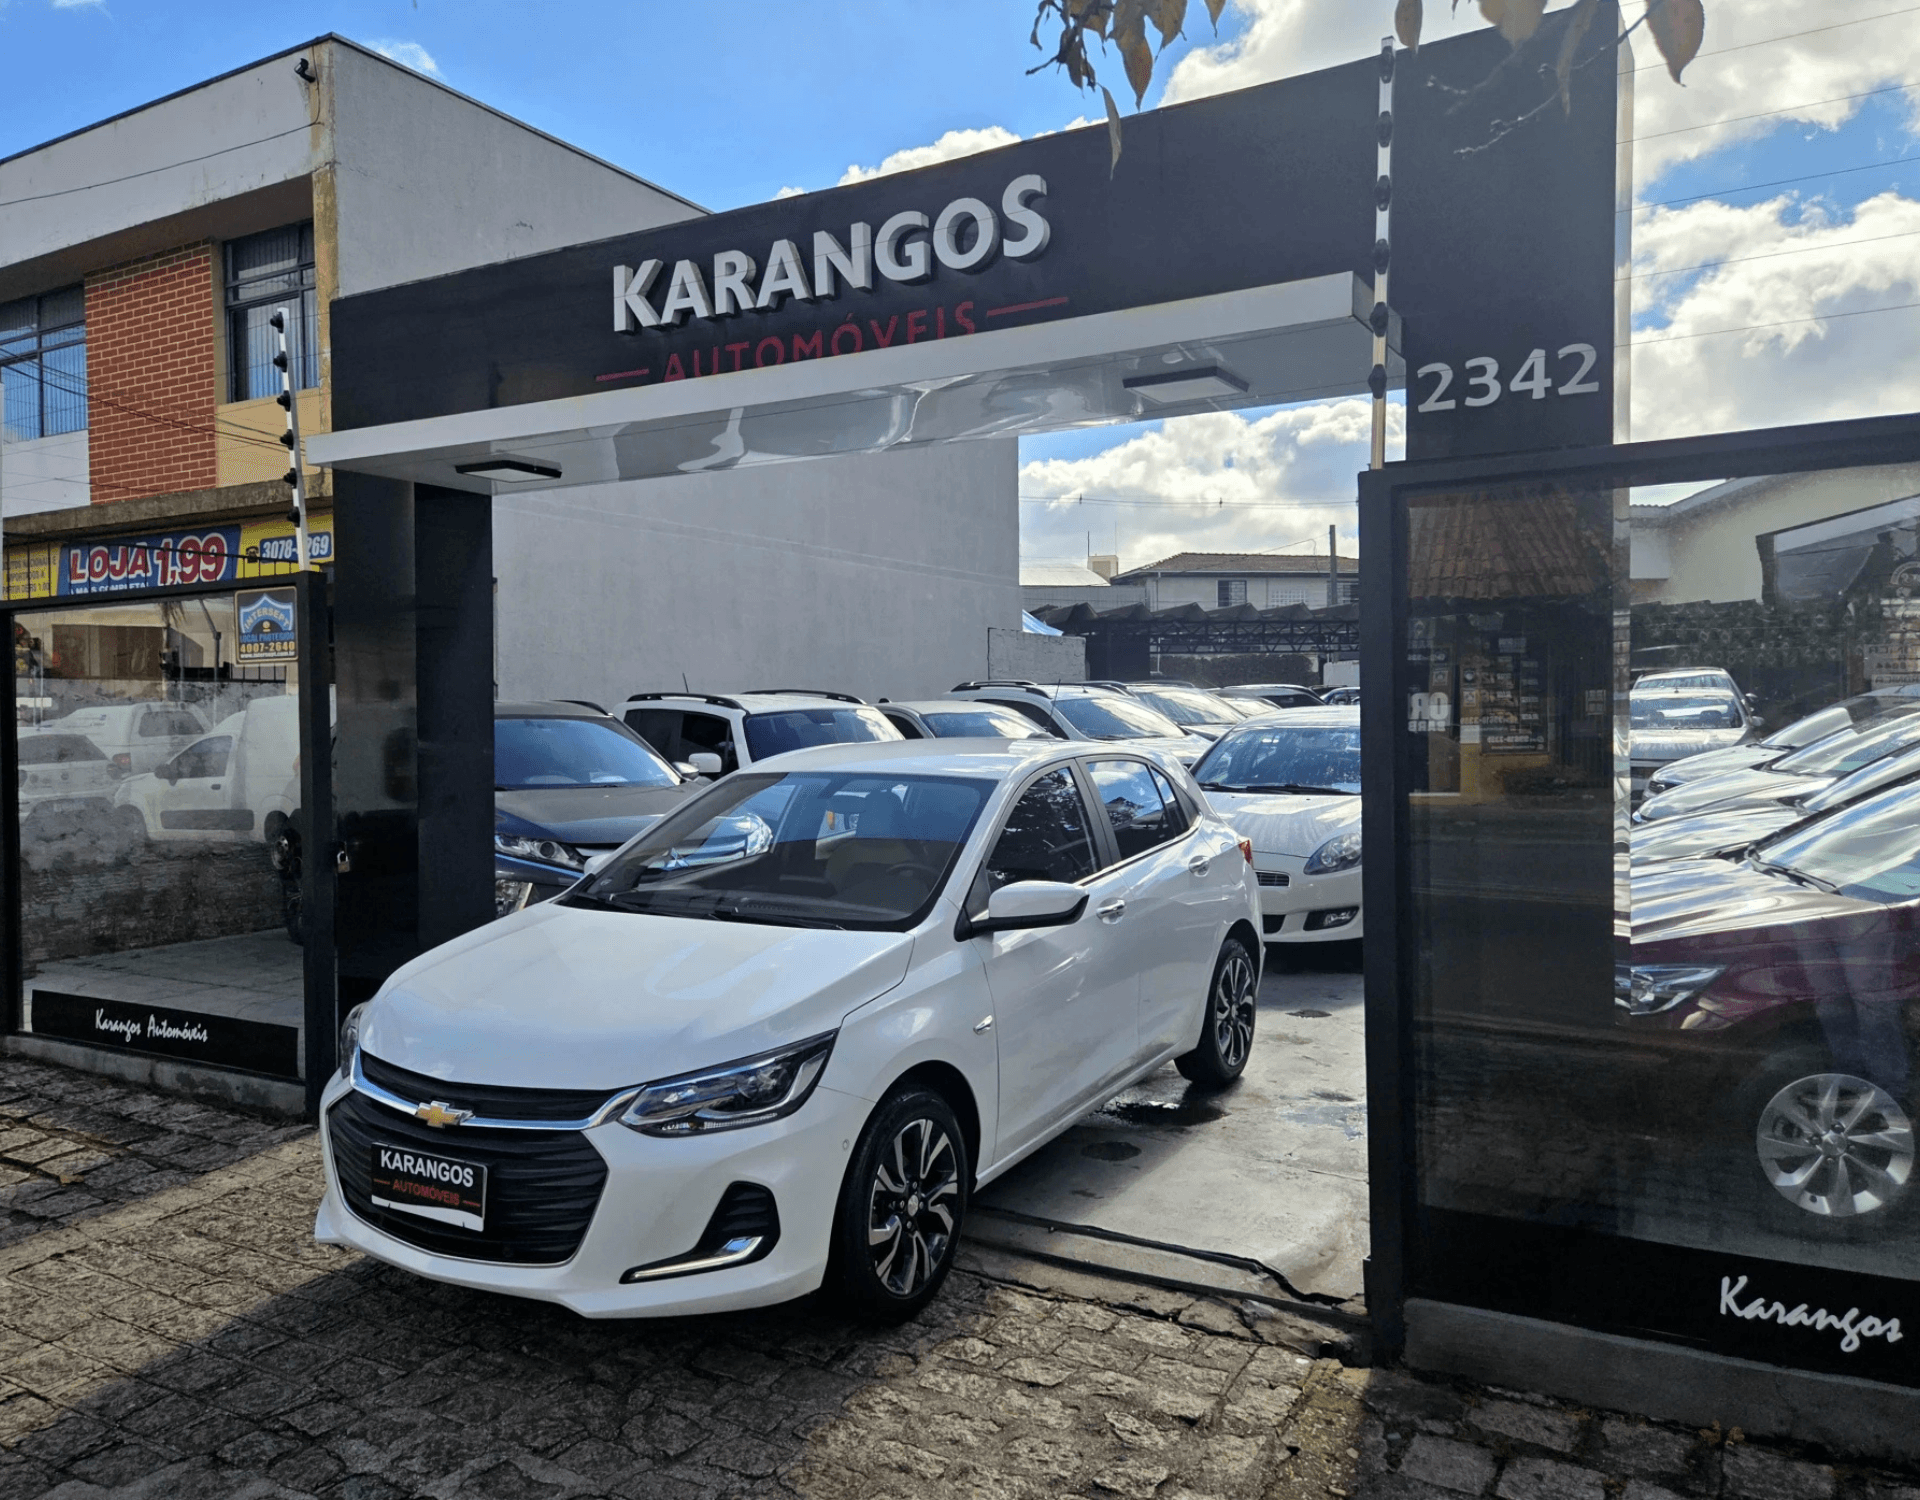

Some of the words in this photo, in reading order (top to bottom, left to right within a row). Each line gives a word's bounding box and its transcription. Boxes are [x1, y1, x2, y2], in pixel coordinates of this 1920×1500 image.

[612, 174, 1050, 333] KARANGOS
[1417, 343, 1599, 413] 2342
[69, 542, 152, 584] LOJA
[240, 641, 295, 653] 4007-2640
[95, 1008, 141, 1043] Karangos
[381, 1149, 474, 1187] KARANGOS
[392, 1179, 460, 1205] AUTOMÓVEIS
[1720, 1275, 1903, 1352] Karangos
